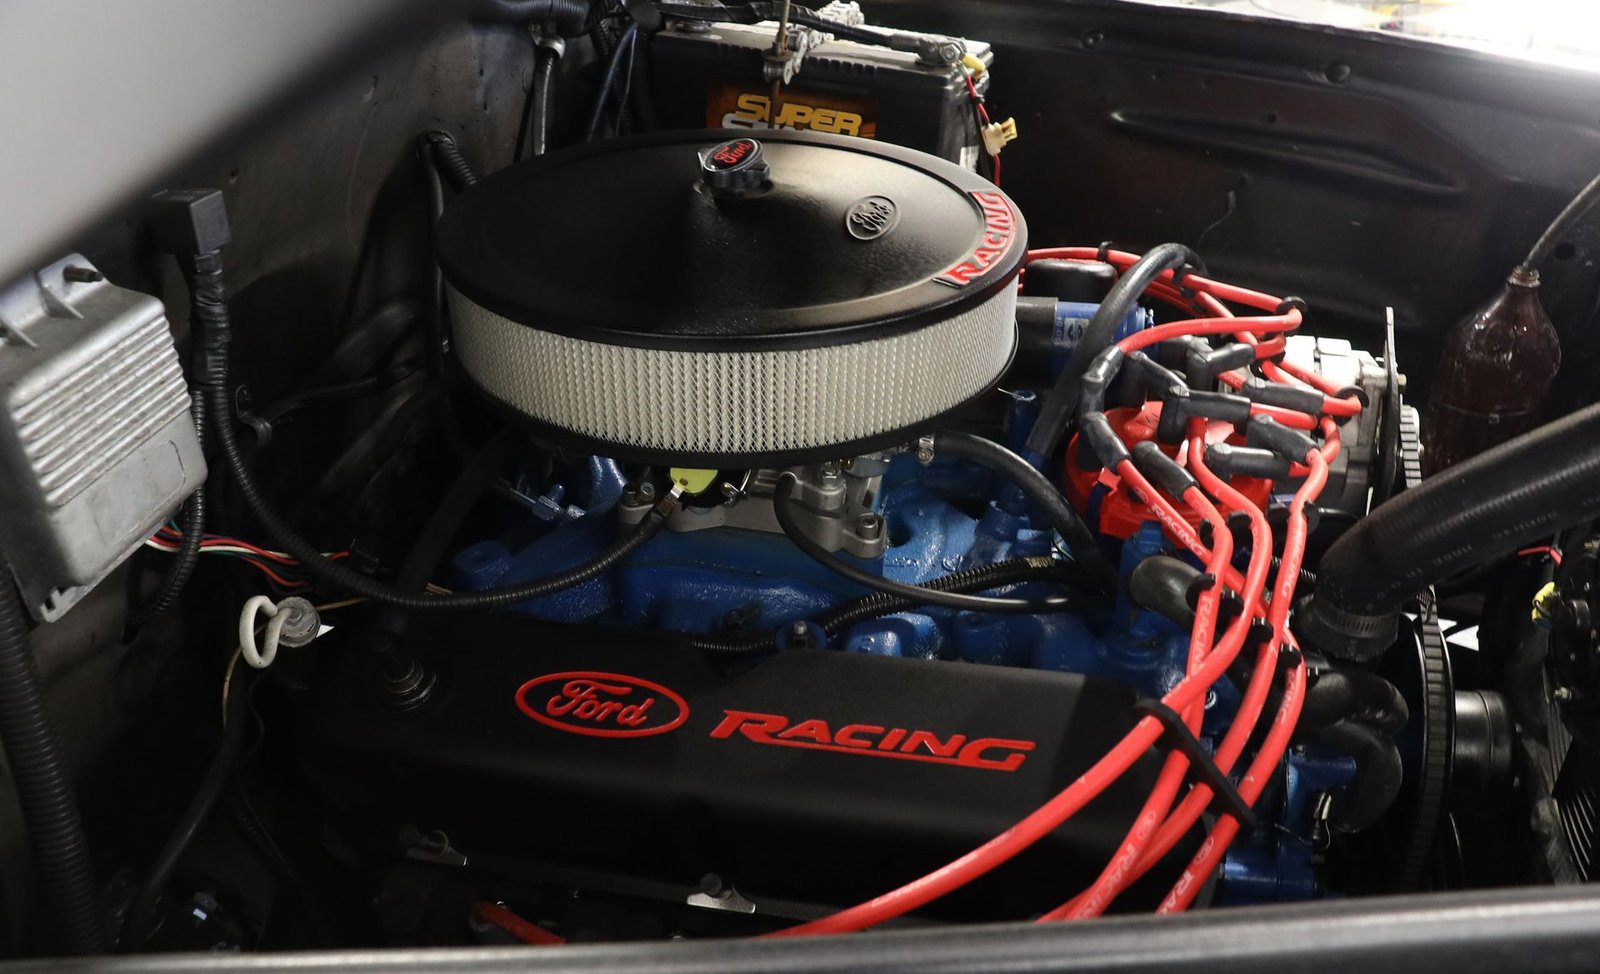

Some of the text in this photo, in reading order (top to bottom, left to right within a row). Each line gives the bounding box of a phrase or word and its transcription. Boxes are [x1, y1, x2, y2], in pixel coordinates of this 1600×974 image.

[735, 93, 863, 137] SUPER
[944, 190, 1016, 285] RACING
[1151, 502, 1206, 557] RACING
[546, 679, 655, 727] Ford
[709, 709, 1036, 772] RACING
[1078, 844, 1137, 920] RACIN
